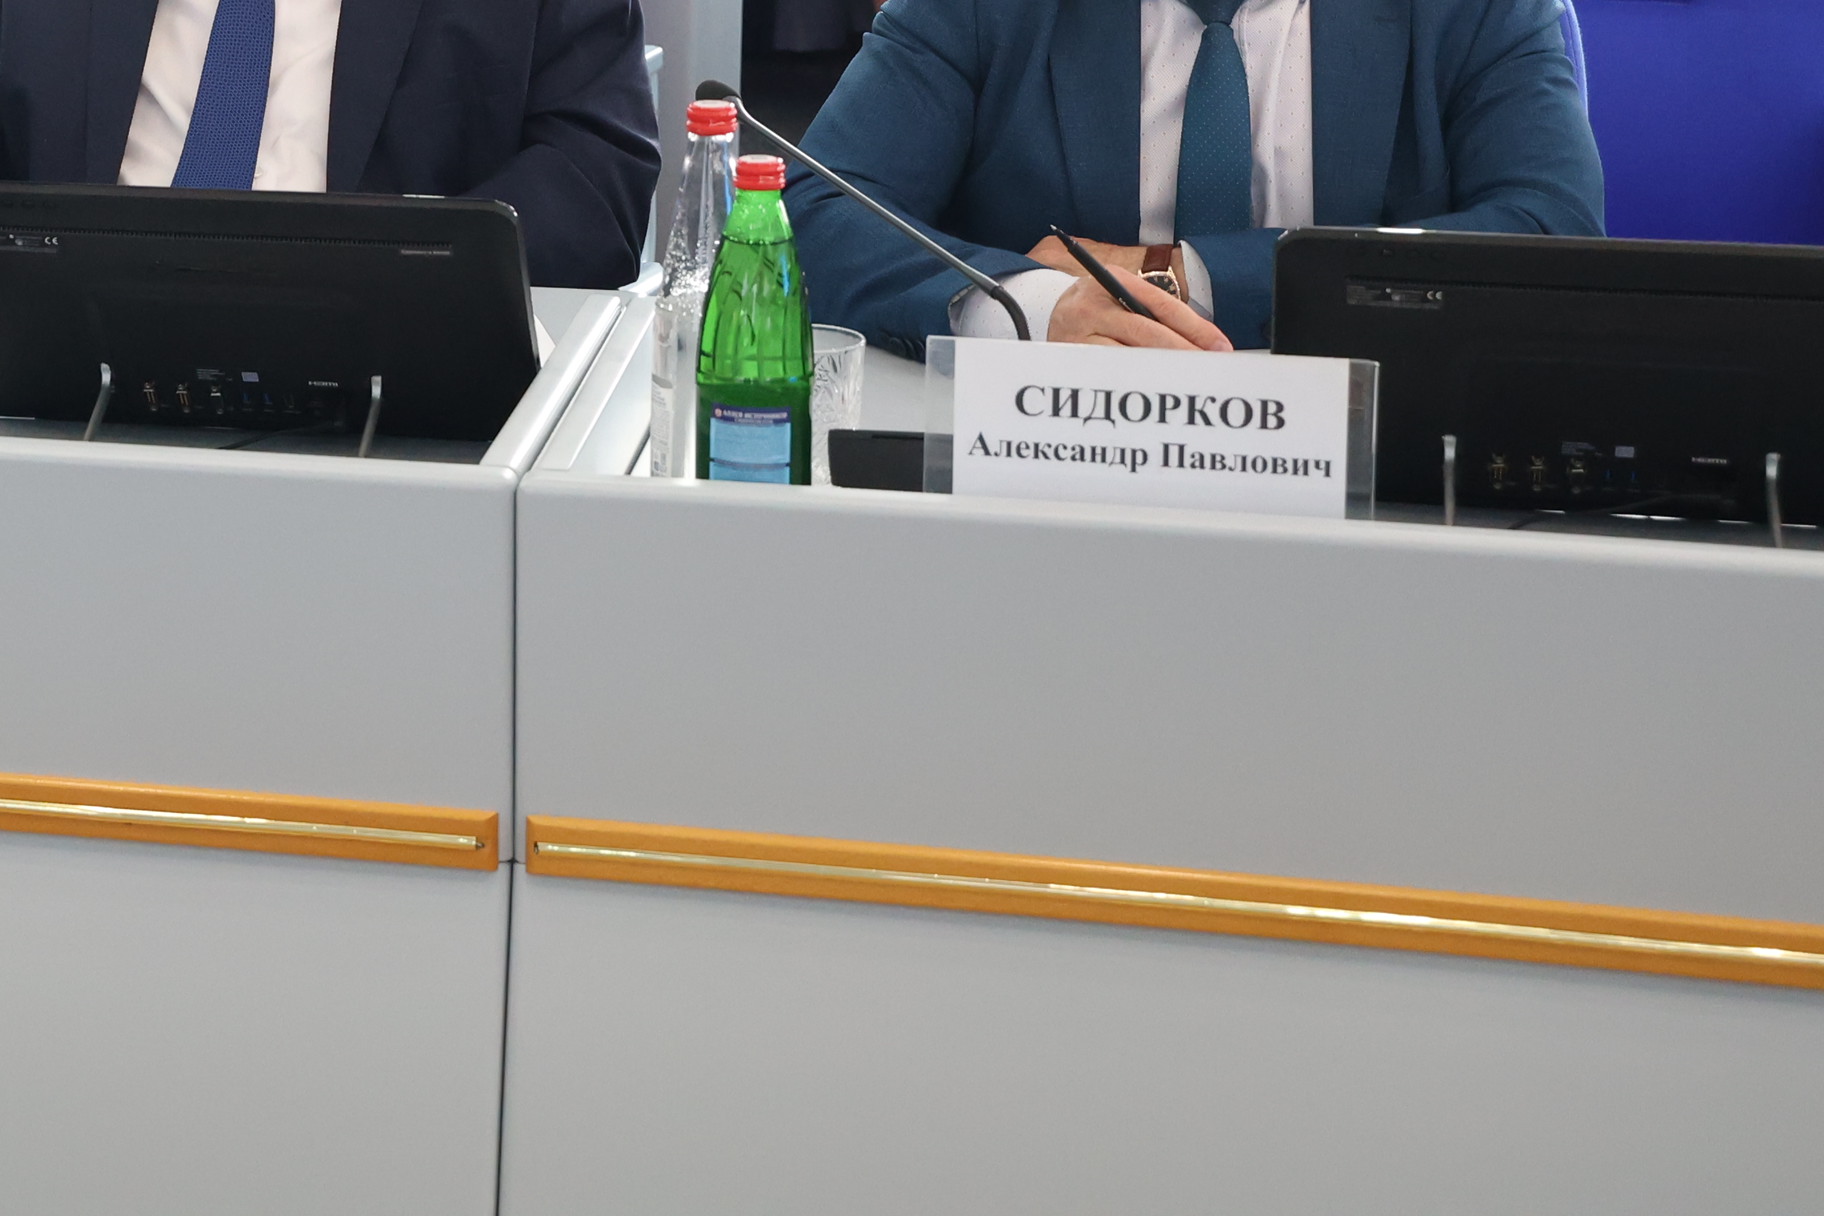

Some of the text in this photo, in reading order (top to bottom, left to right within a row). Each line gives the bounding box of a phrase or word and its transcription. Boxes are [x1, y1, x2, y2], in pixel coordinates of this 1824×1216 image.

[1013, 384, 1287, 432] СИДОРКОВ
[967, 431, 1333, 479] Александр Павлович
